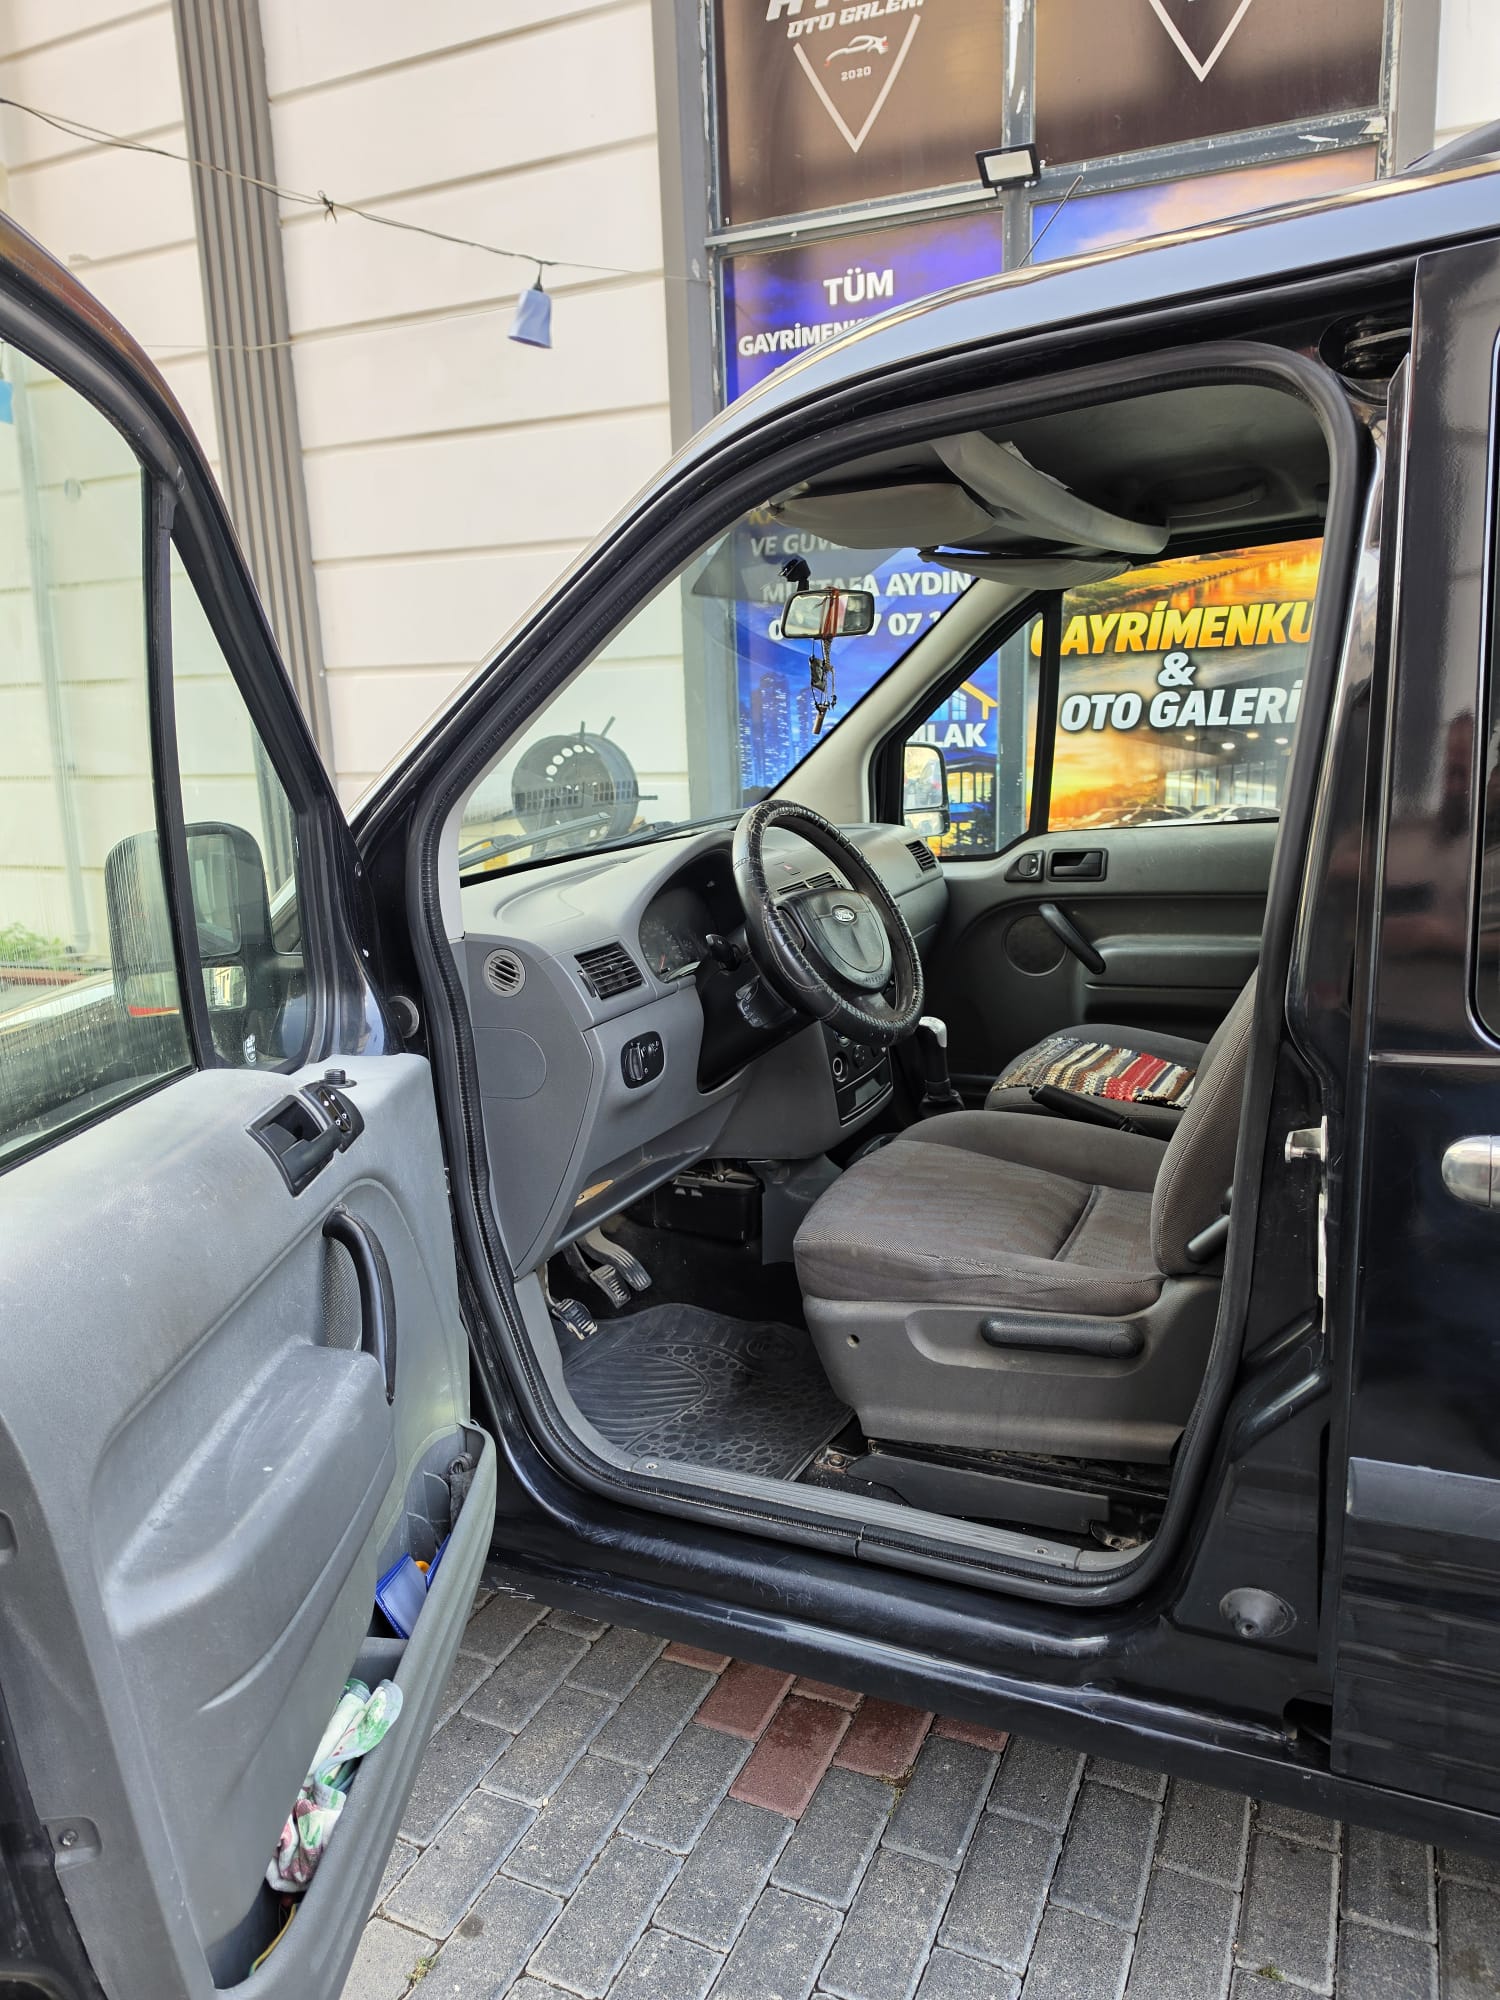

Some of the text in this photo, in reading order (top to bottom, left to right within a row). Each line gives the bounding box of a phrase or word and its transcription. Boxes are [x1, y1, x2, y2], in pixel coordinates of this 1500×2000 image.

[787, 12, 836, 39] OTO
[841, 66, 872, 82] 2020
[822, 267, 894, 306] TÜM
[750, 536, 778, 558] VE
[885, 570, 972, 596] AYDIN
[888, 612, 922, 636] 07
[1157, 652, 1196, 687] &
[1061, 680, 1303, 731] OTO GALERİ
